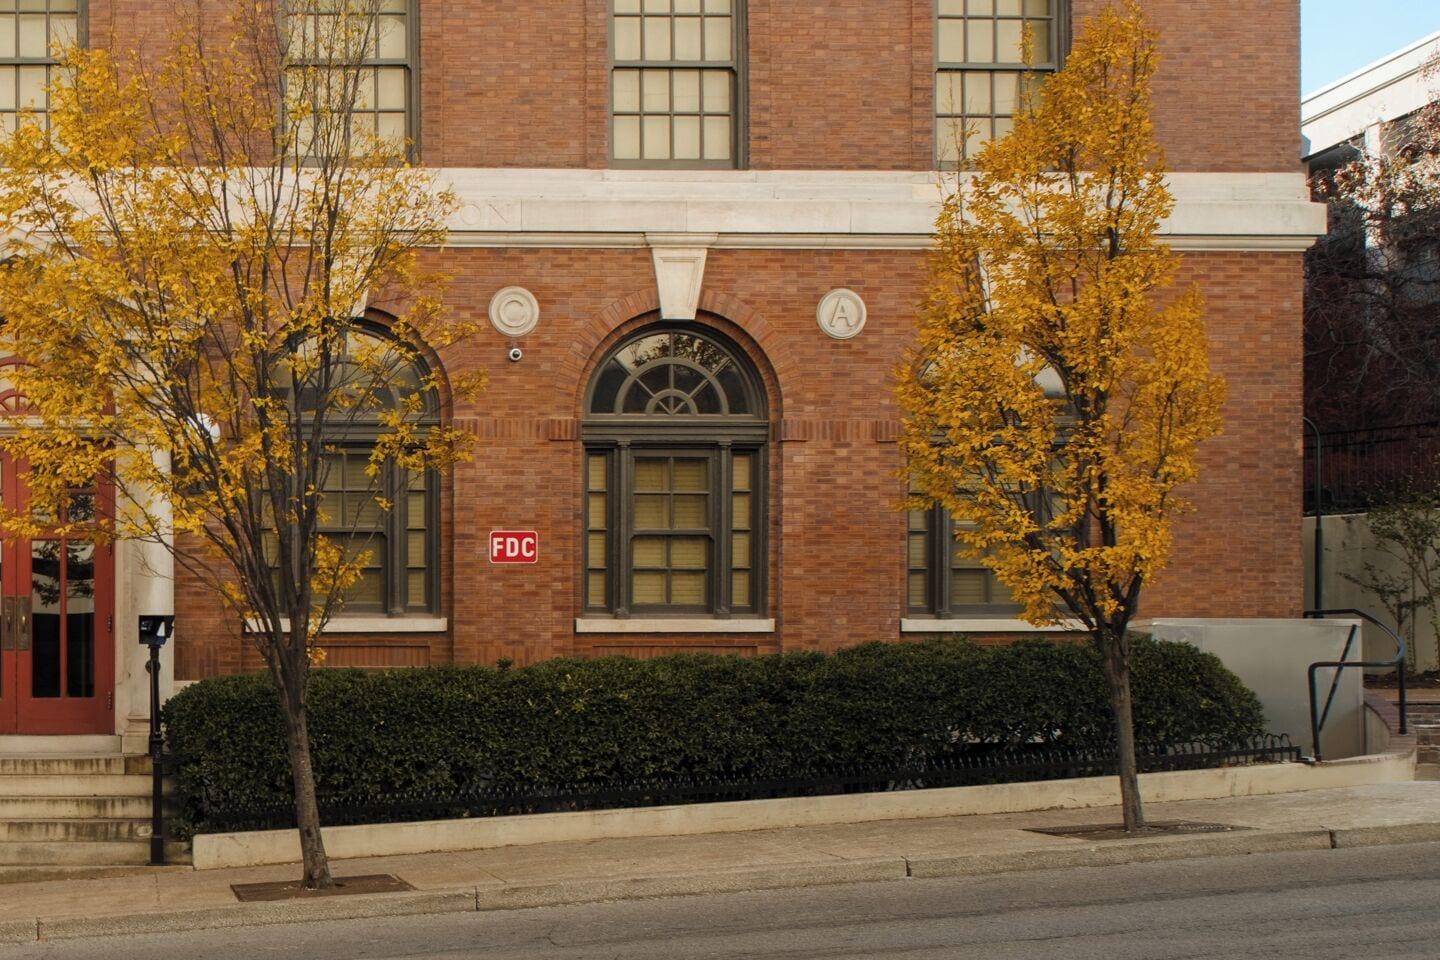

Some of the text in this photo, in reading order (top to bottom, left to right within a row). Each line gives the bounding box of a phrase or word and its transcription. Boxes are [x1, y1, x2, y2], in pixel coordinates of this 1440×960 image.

[498, 296, 526, 328] C
[828, 296, 858, 328] A
[492, 537, 535, 558] FDC
